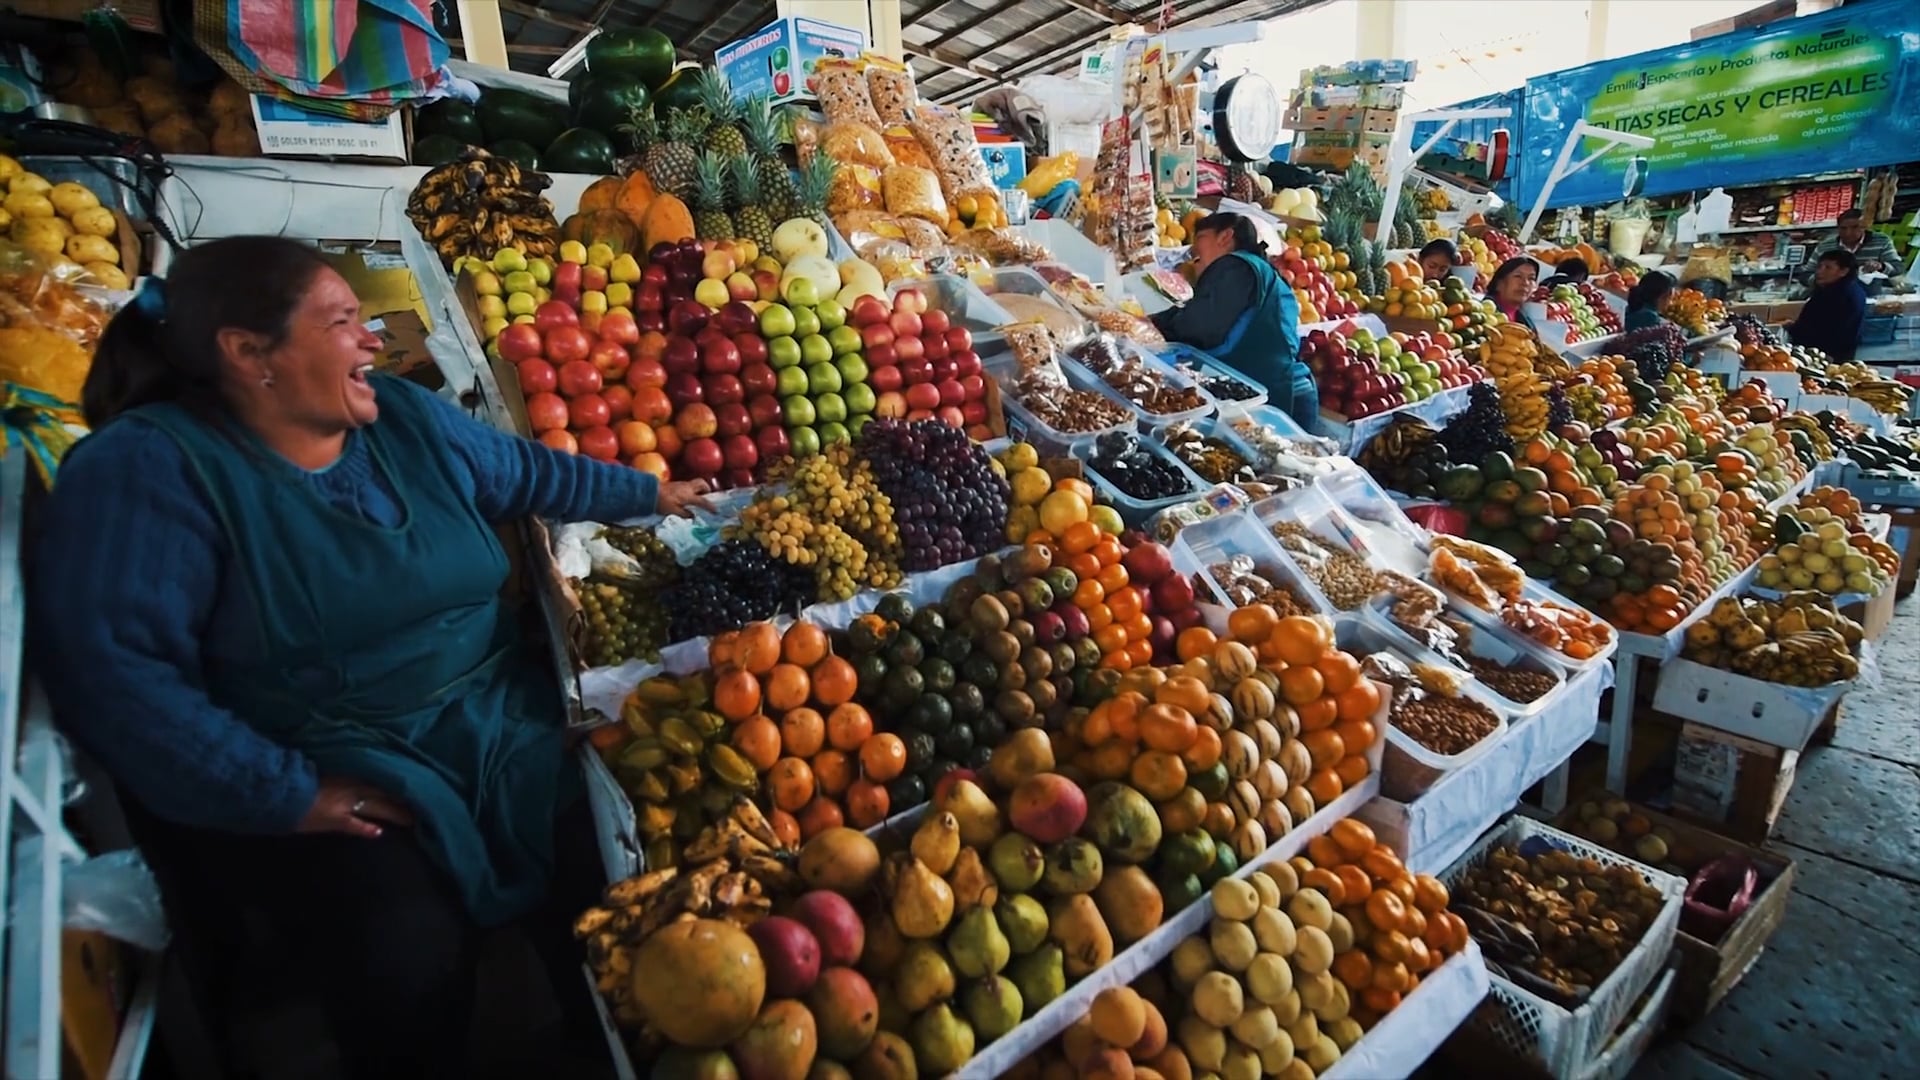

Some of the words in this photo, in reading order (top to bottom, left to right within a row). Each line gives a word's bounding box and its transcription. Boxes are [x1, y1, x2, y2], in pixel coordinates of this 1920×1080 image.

[1709, 65, 1717, 75] y
[1721, 50, 1789, 71] Productos
[1795, 34, 1870, 56] Naturales
[1587, 112, 1653, 133] UTAS
[1657, 100, 1725, 127] SECAS
[1735, 95, 1750, 113] Y
[1759, 71, 1893, 109] CEREALES
